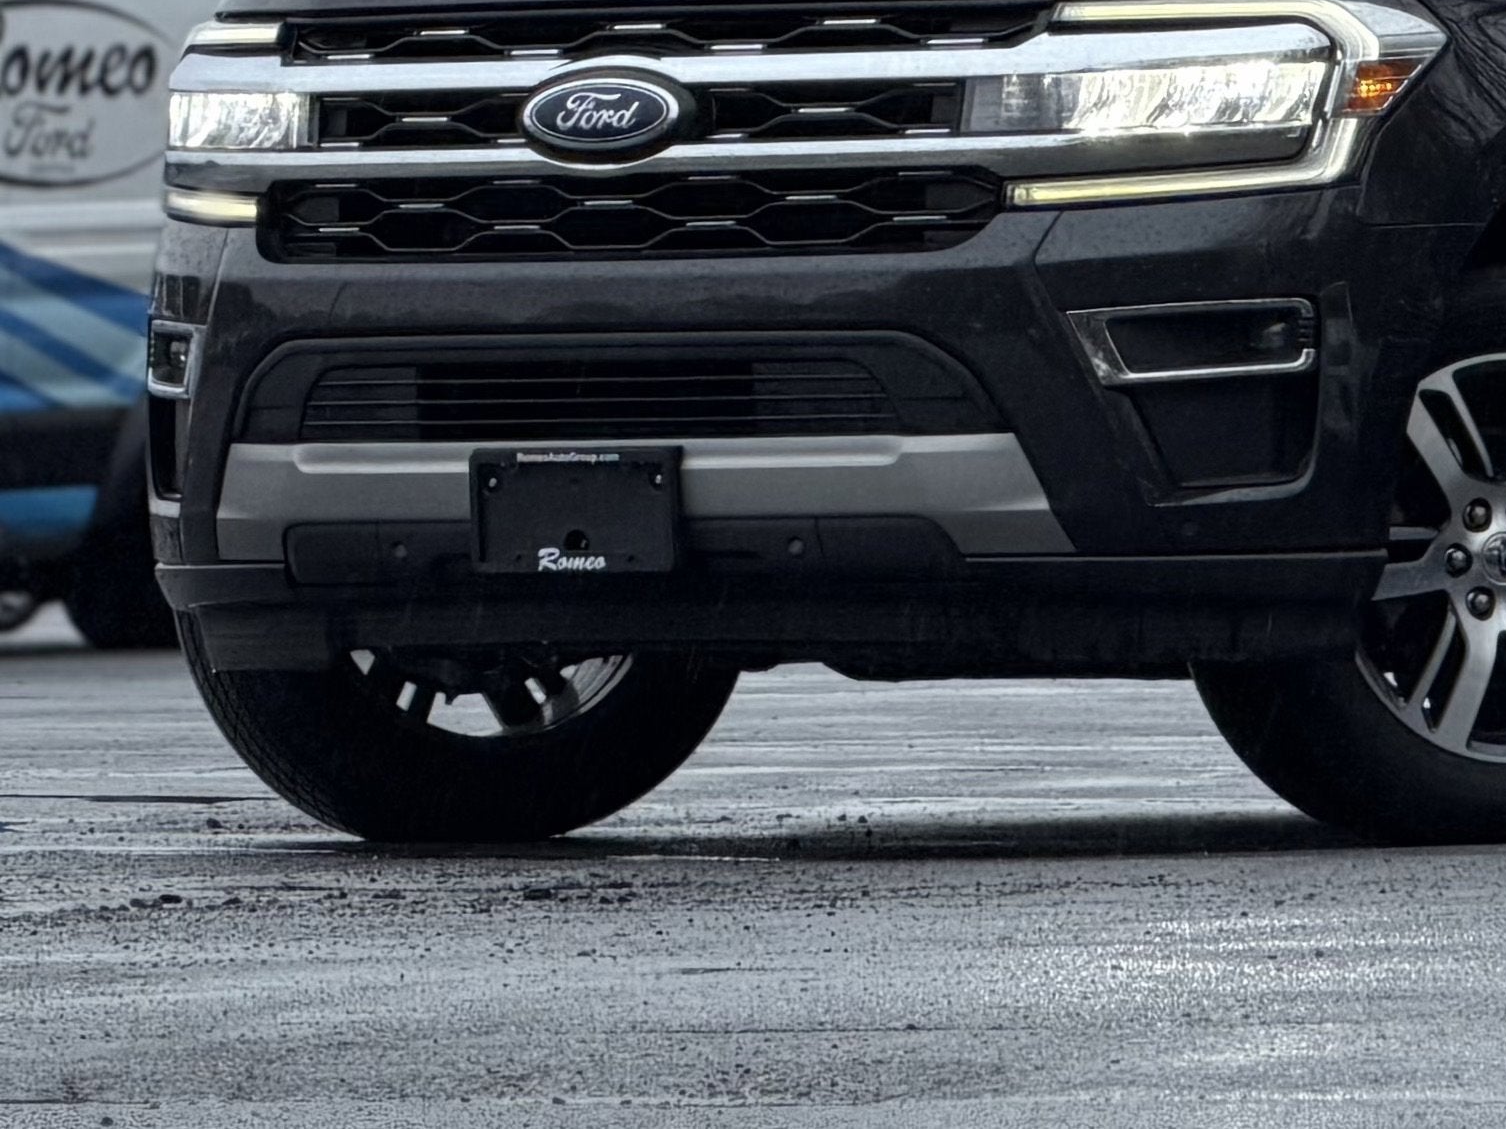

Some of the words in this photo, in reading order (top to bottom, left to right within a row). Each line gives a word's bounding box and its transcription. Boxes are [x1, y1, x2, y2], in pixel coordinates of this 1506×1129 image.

[0, 12, 157, 97] omeo
[4, 101, 95, 158] Ford
[557, 92, 639, 130] Ford
[538, 547, 606, 571] Romeo
